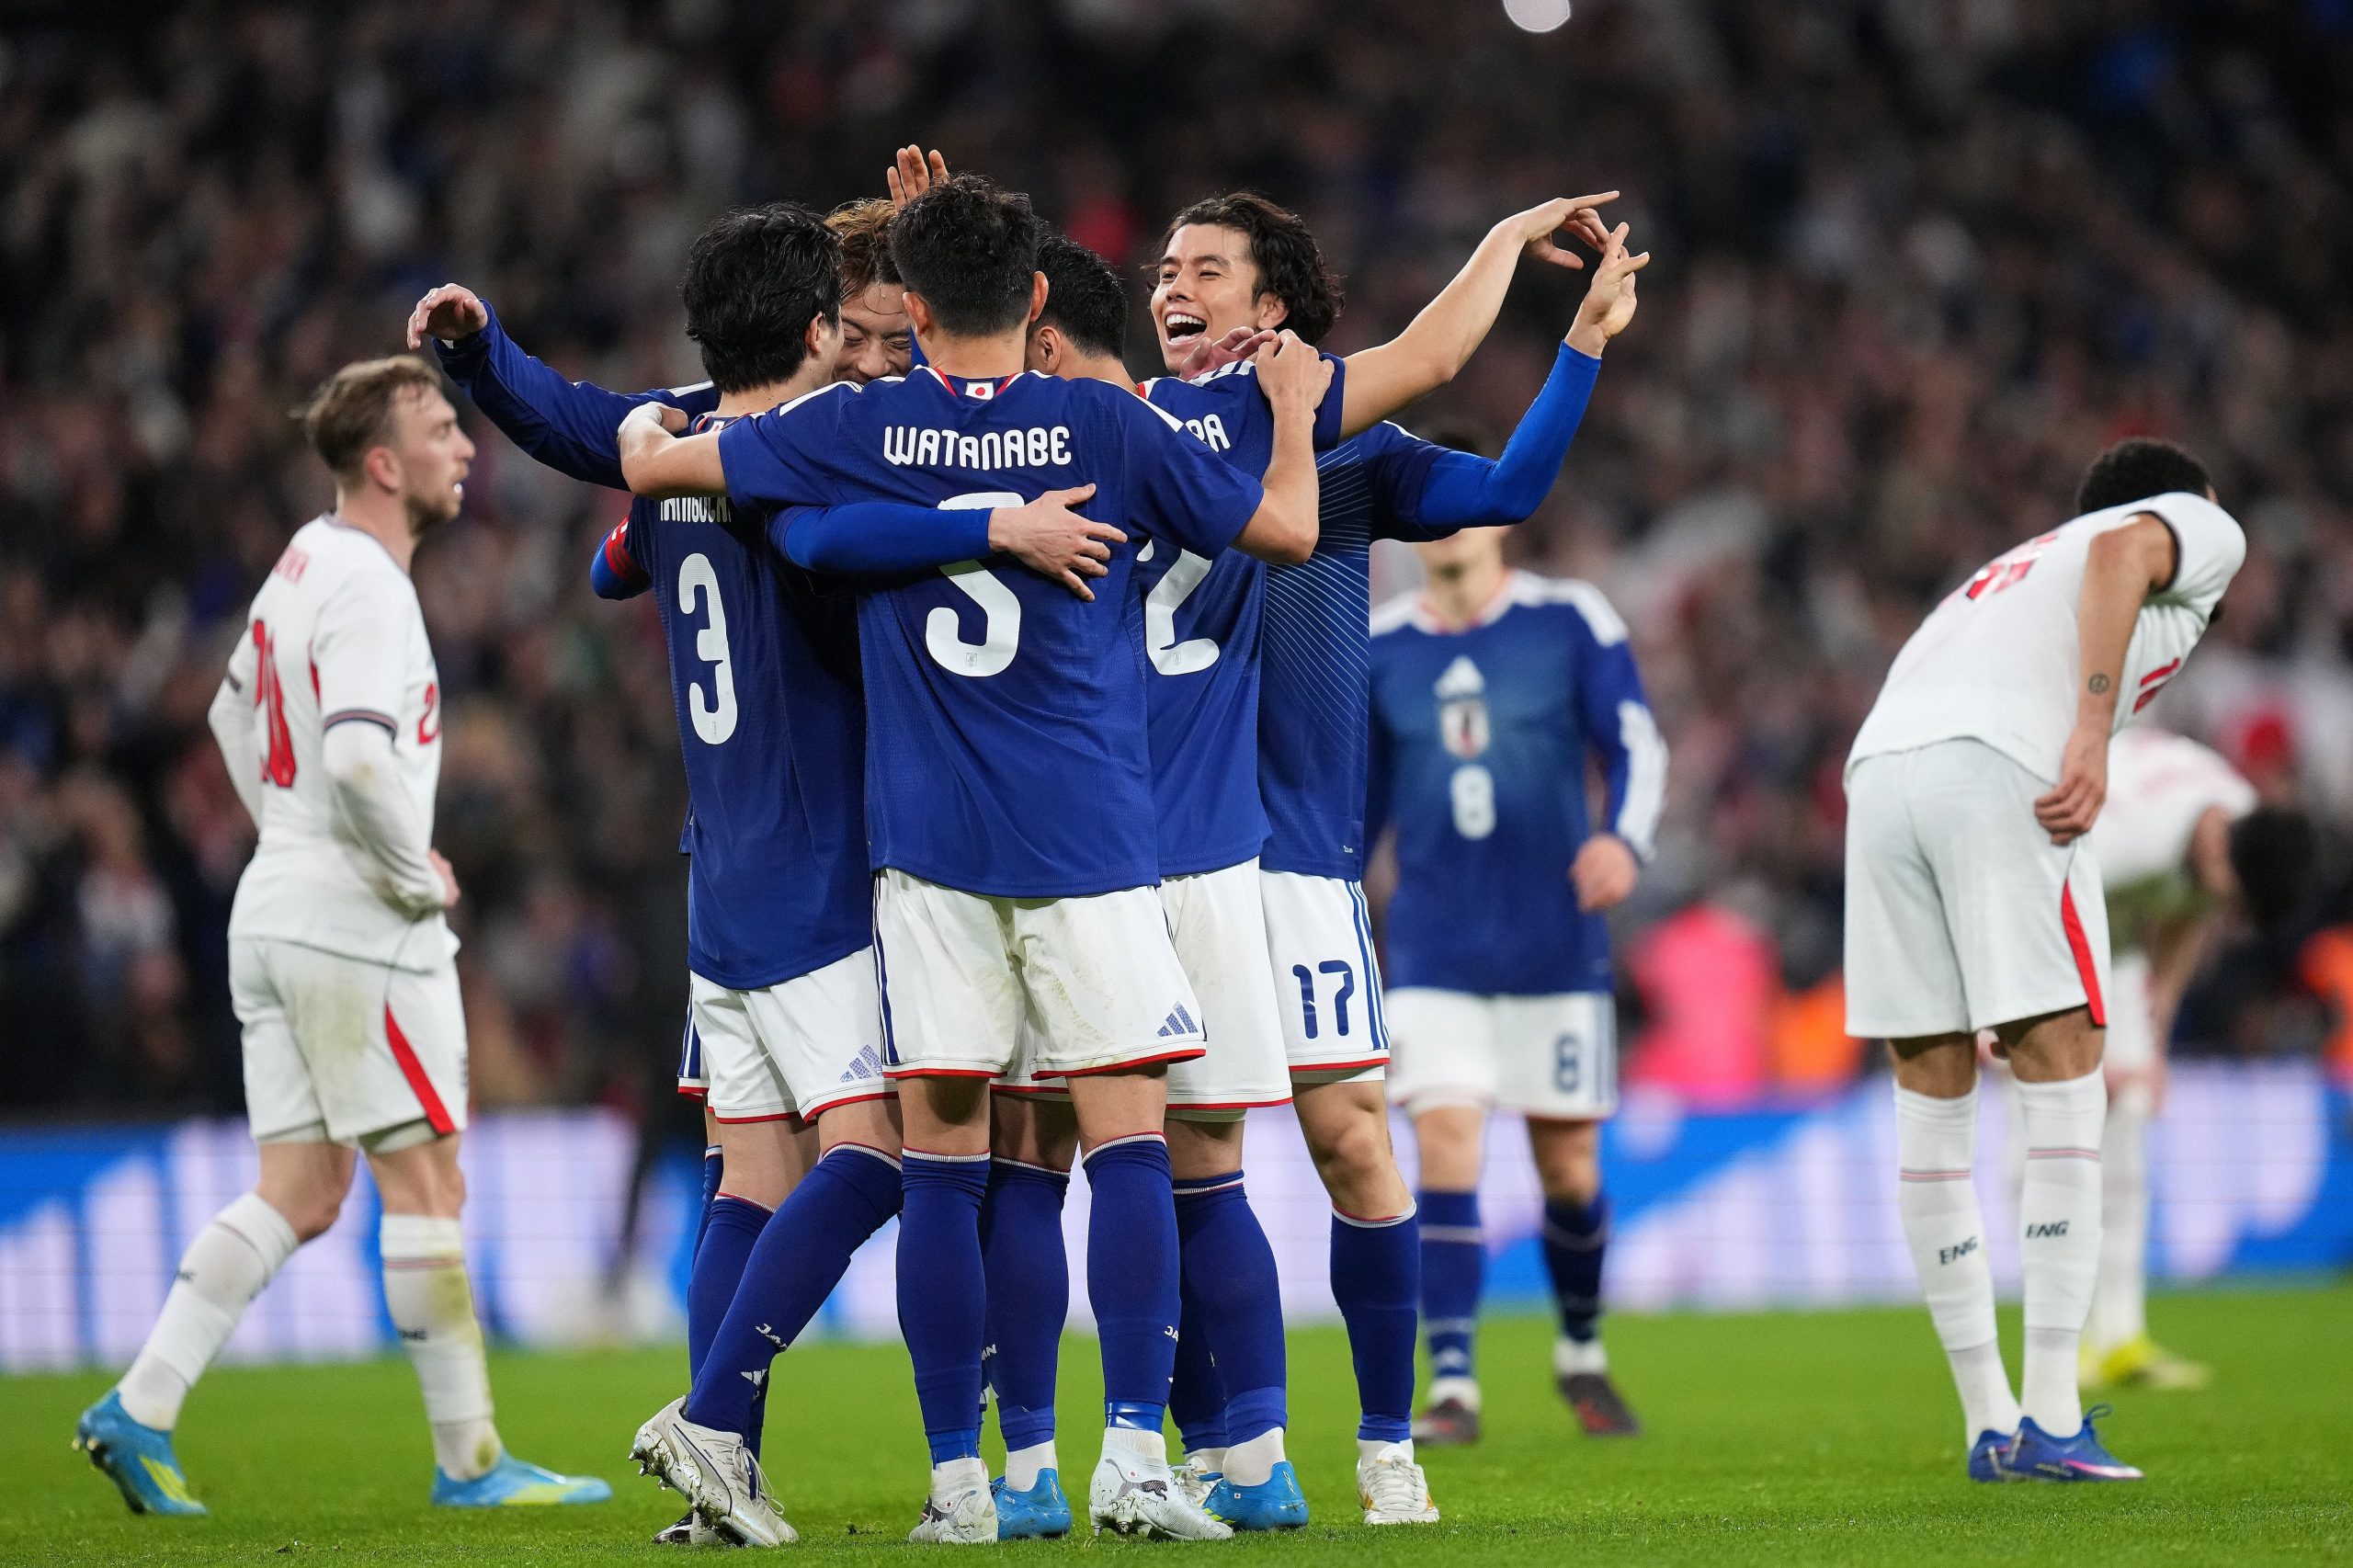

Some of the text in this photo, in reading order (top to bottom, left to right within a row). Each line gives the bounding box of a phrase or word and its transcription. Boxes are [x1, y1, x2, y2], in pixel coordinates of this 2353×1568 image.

[883, 426, 1072, 471] WATANABE
[678, 553, 738, 745] 3
[1292, 960, 1355, 1040] 17
[1938, 1235, 1978, 1267] ENG
[2026, 1220, 2070, 1239] ENG
